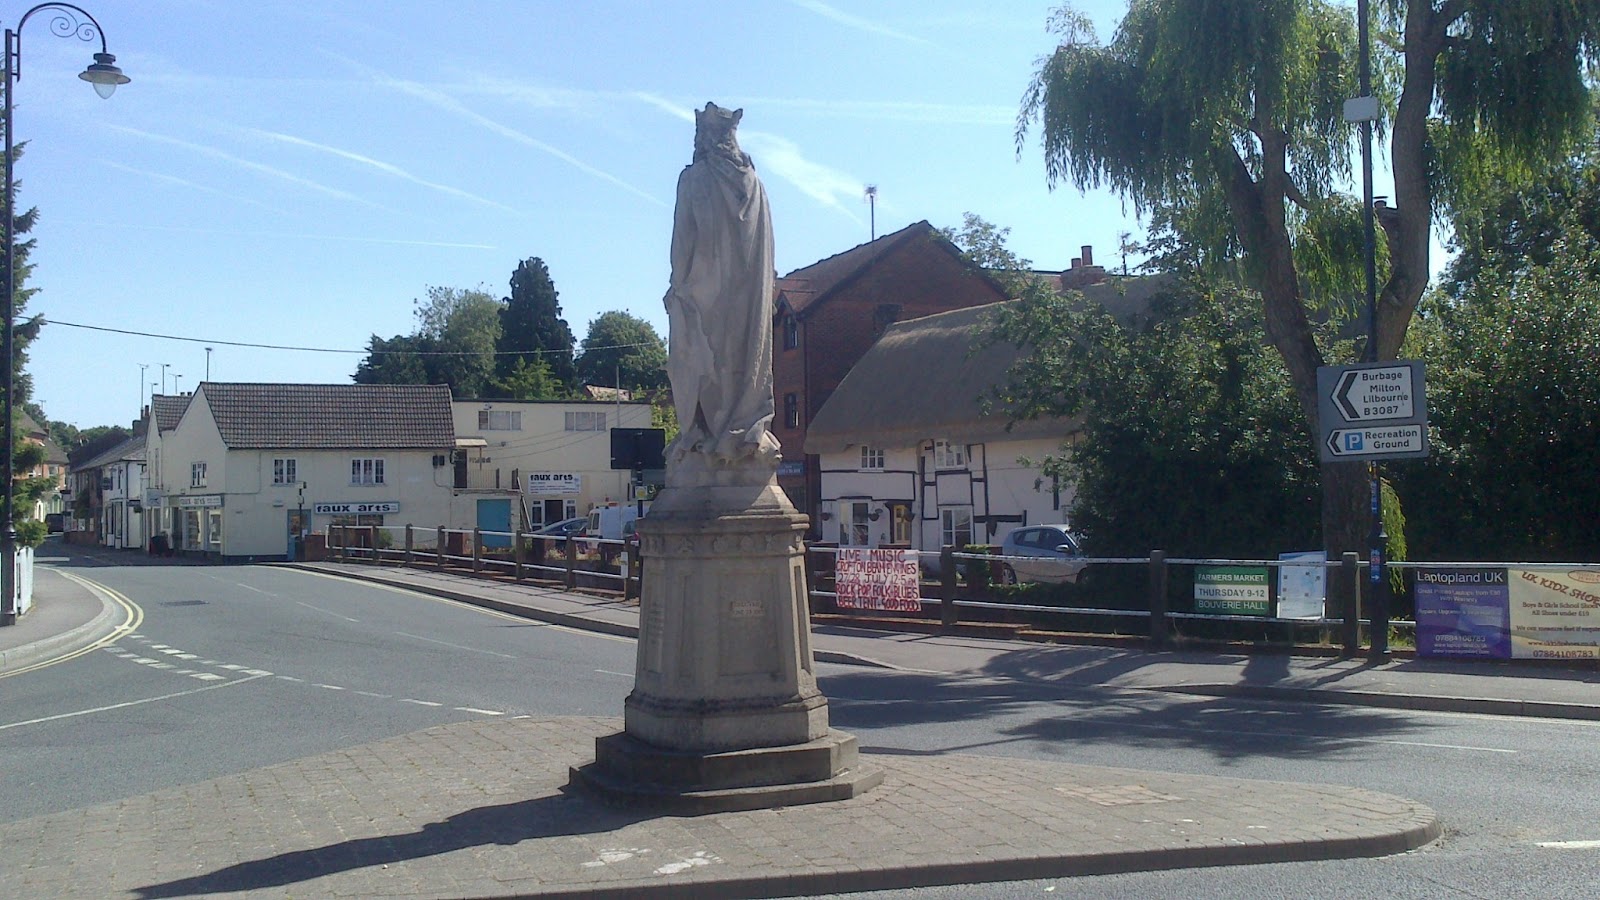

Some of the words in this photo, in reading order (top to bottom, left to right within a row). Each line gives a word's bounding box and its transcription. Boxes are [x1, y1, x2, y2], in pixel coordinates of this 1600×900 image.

[1362, 371, 1403, 382] Burbage
[1370, 384, 1401, 393] Milton
[1363, 393, 1409, 404] Lilbourne
[1365, 429, 1418, 440] Recreation
[1373, 439, 1410, 449] Ground
[317, 504, 350, 513] faux
[358, 504, 390, 512] arts
[839, 549, 861, 561] LIVE
[870, 549, 906, 563] MUSIC
[864, 573, 888, 585] JULY
[1198, 573, 1232, 582] FARMERS
[1233, 574, 1264, 582] MARKET
[1417, 571, 1480, 585] Laptopland
[1484, 572, 1503, 582] UK
[835, 583, 856, 595] ROCK
[857, 584, 872, 596] POP
[872, 584, 891, 598] FOLK
[893, 585, 919, 599] BLUES
[1198, 588, 1245, 597] THURSDAY
[1247, 589, 1265, 598] 9-12
[1522, 571, 1538, 584] UK
[1540, 577, 1569, 595] KIDZ
[1569, 588, 1600, 607] SHOE
[838, 595, 857, 608] BEER
[858, 596, 878, 609] TENT
[1198, 600, 1241, 610] BOUVERIE
[1243, 601, 1265, 610] HALL
[1522, 601, 1536, 609] Boys
[1533, 650, 1594, 658] 07884108783
